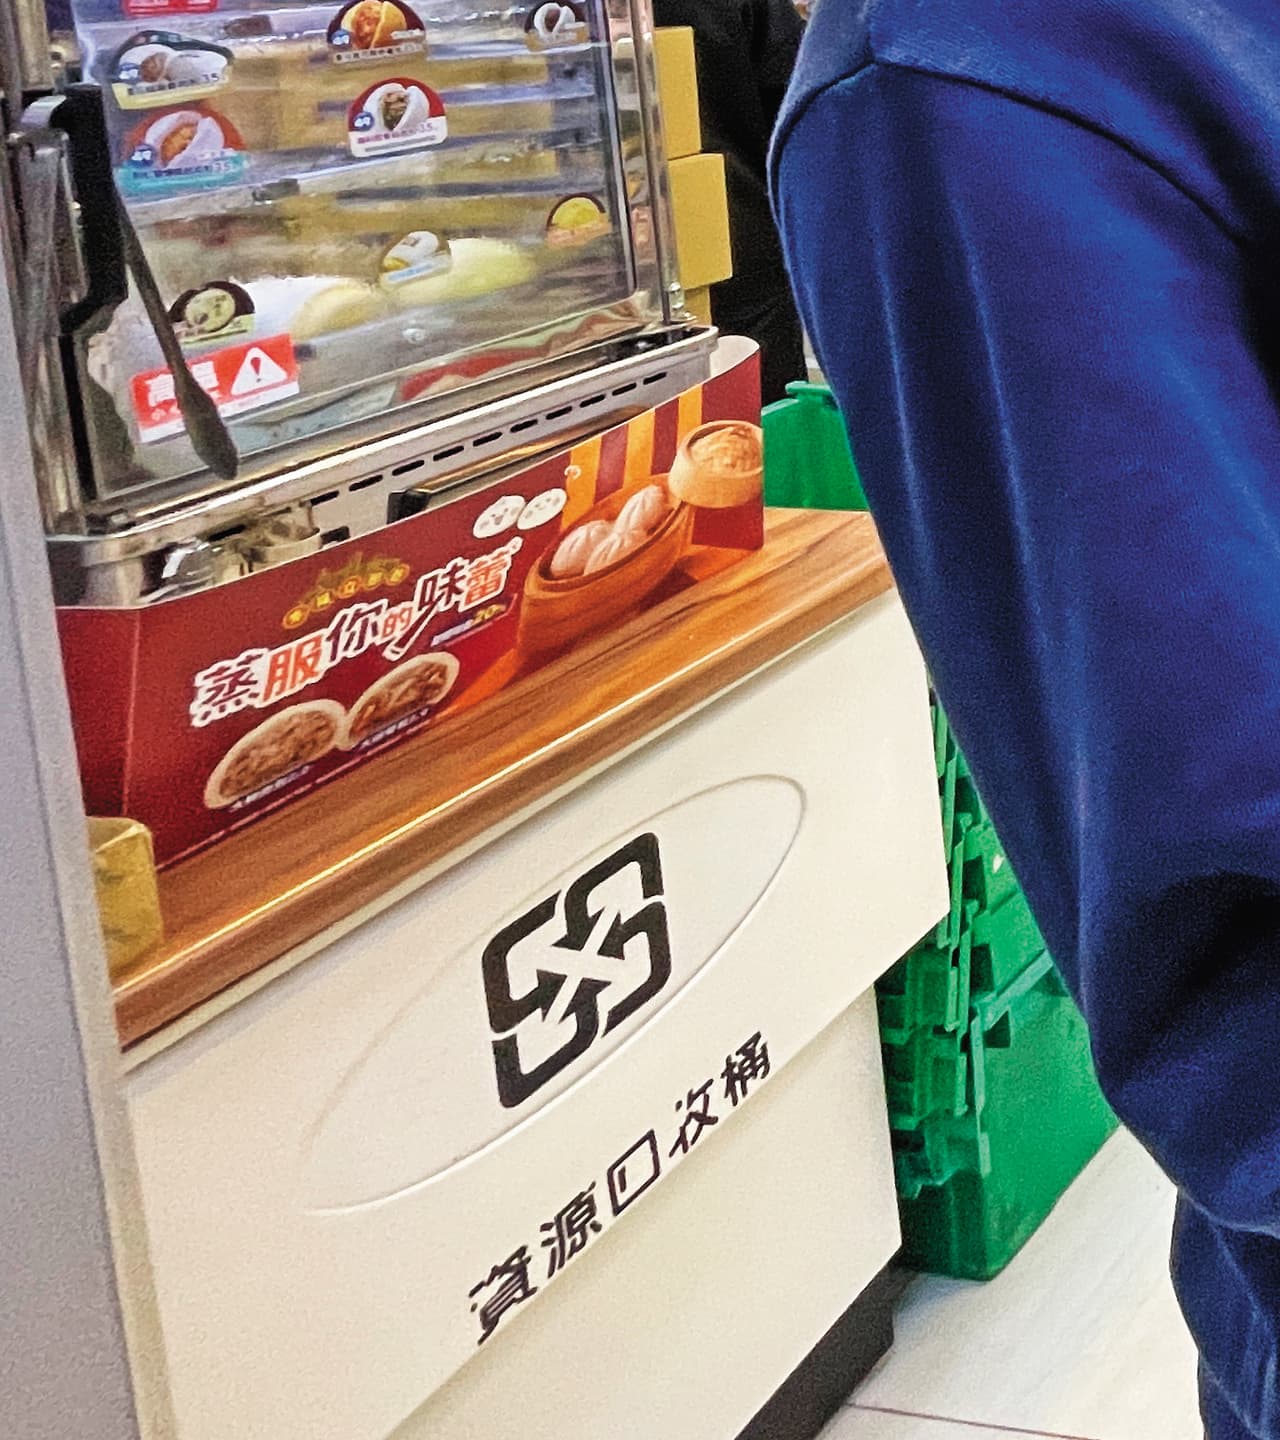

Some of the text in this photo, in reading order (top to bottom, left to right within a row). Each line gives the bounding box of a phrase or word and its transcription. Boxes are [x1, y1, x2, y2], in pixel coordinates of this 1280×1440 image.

[193, 552, 514, 722] 蒸服你的味蕾
[469, 1030, 772, 1344] 資源回收桶
